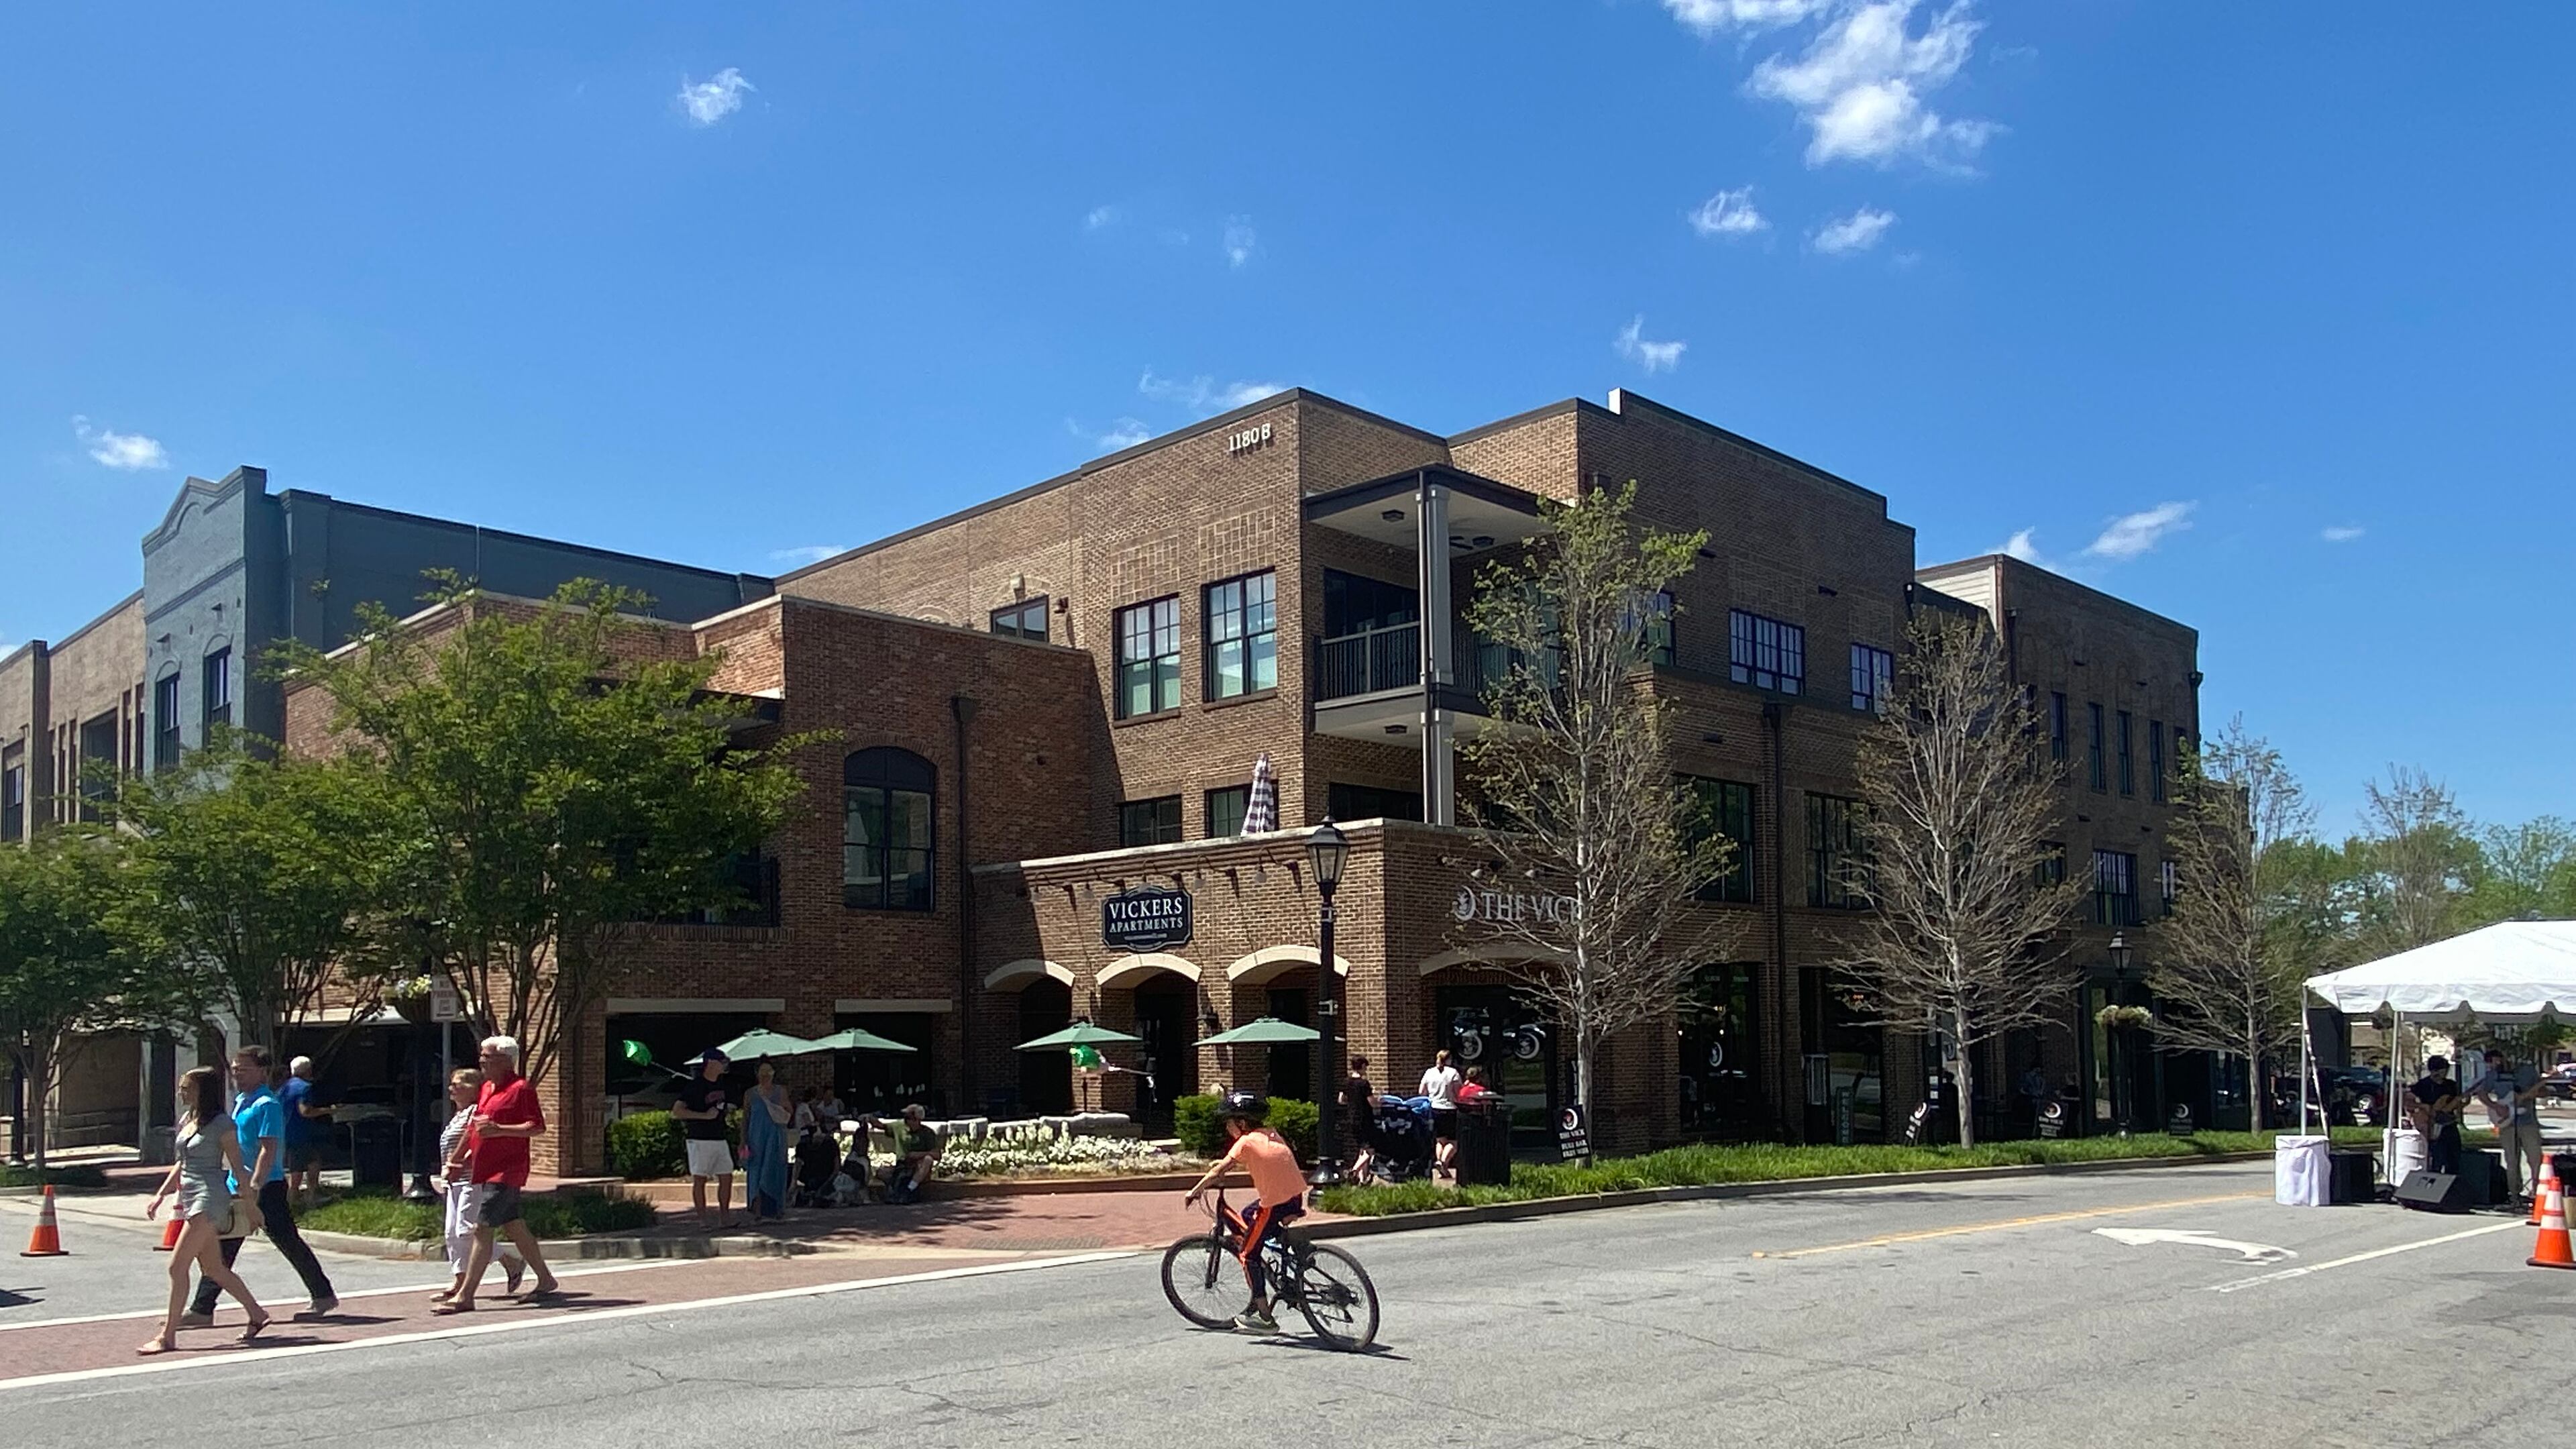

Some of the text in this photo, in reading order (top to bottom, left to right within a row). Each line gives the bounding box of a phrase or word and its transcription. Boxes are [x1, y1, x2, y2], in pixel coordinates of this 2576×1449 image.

[1228, 427, 1260, 451] 1180
[1109, 897, 1183, 919] VICKERS
[1481, 892, 1525, 922] THE
[1109, 916, 1183, 933] APARTMENTS
